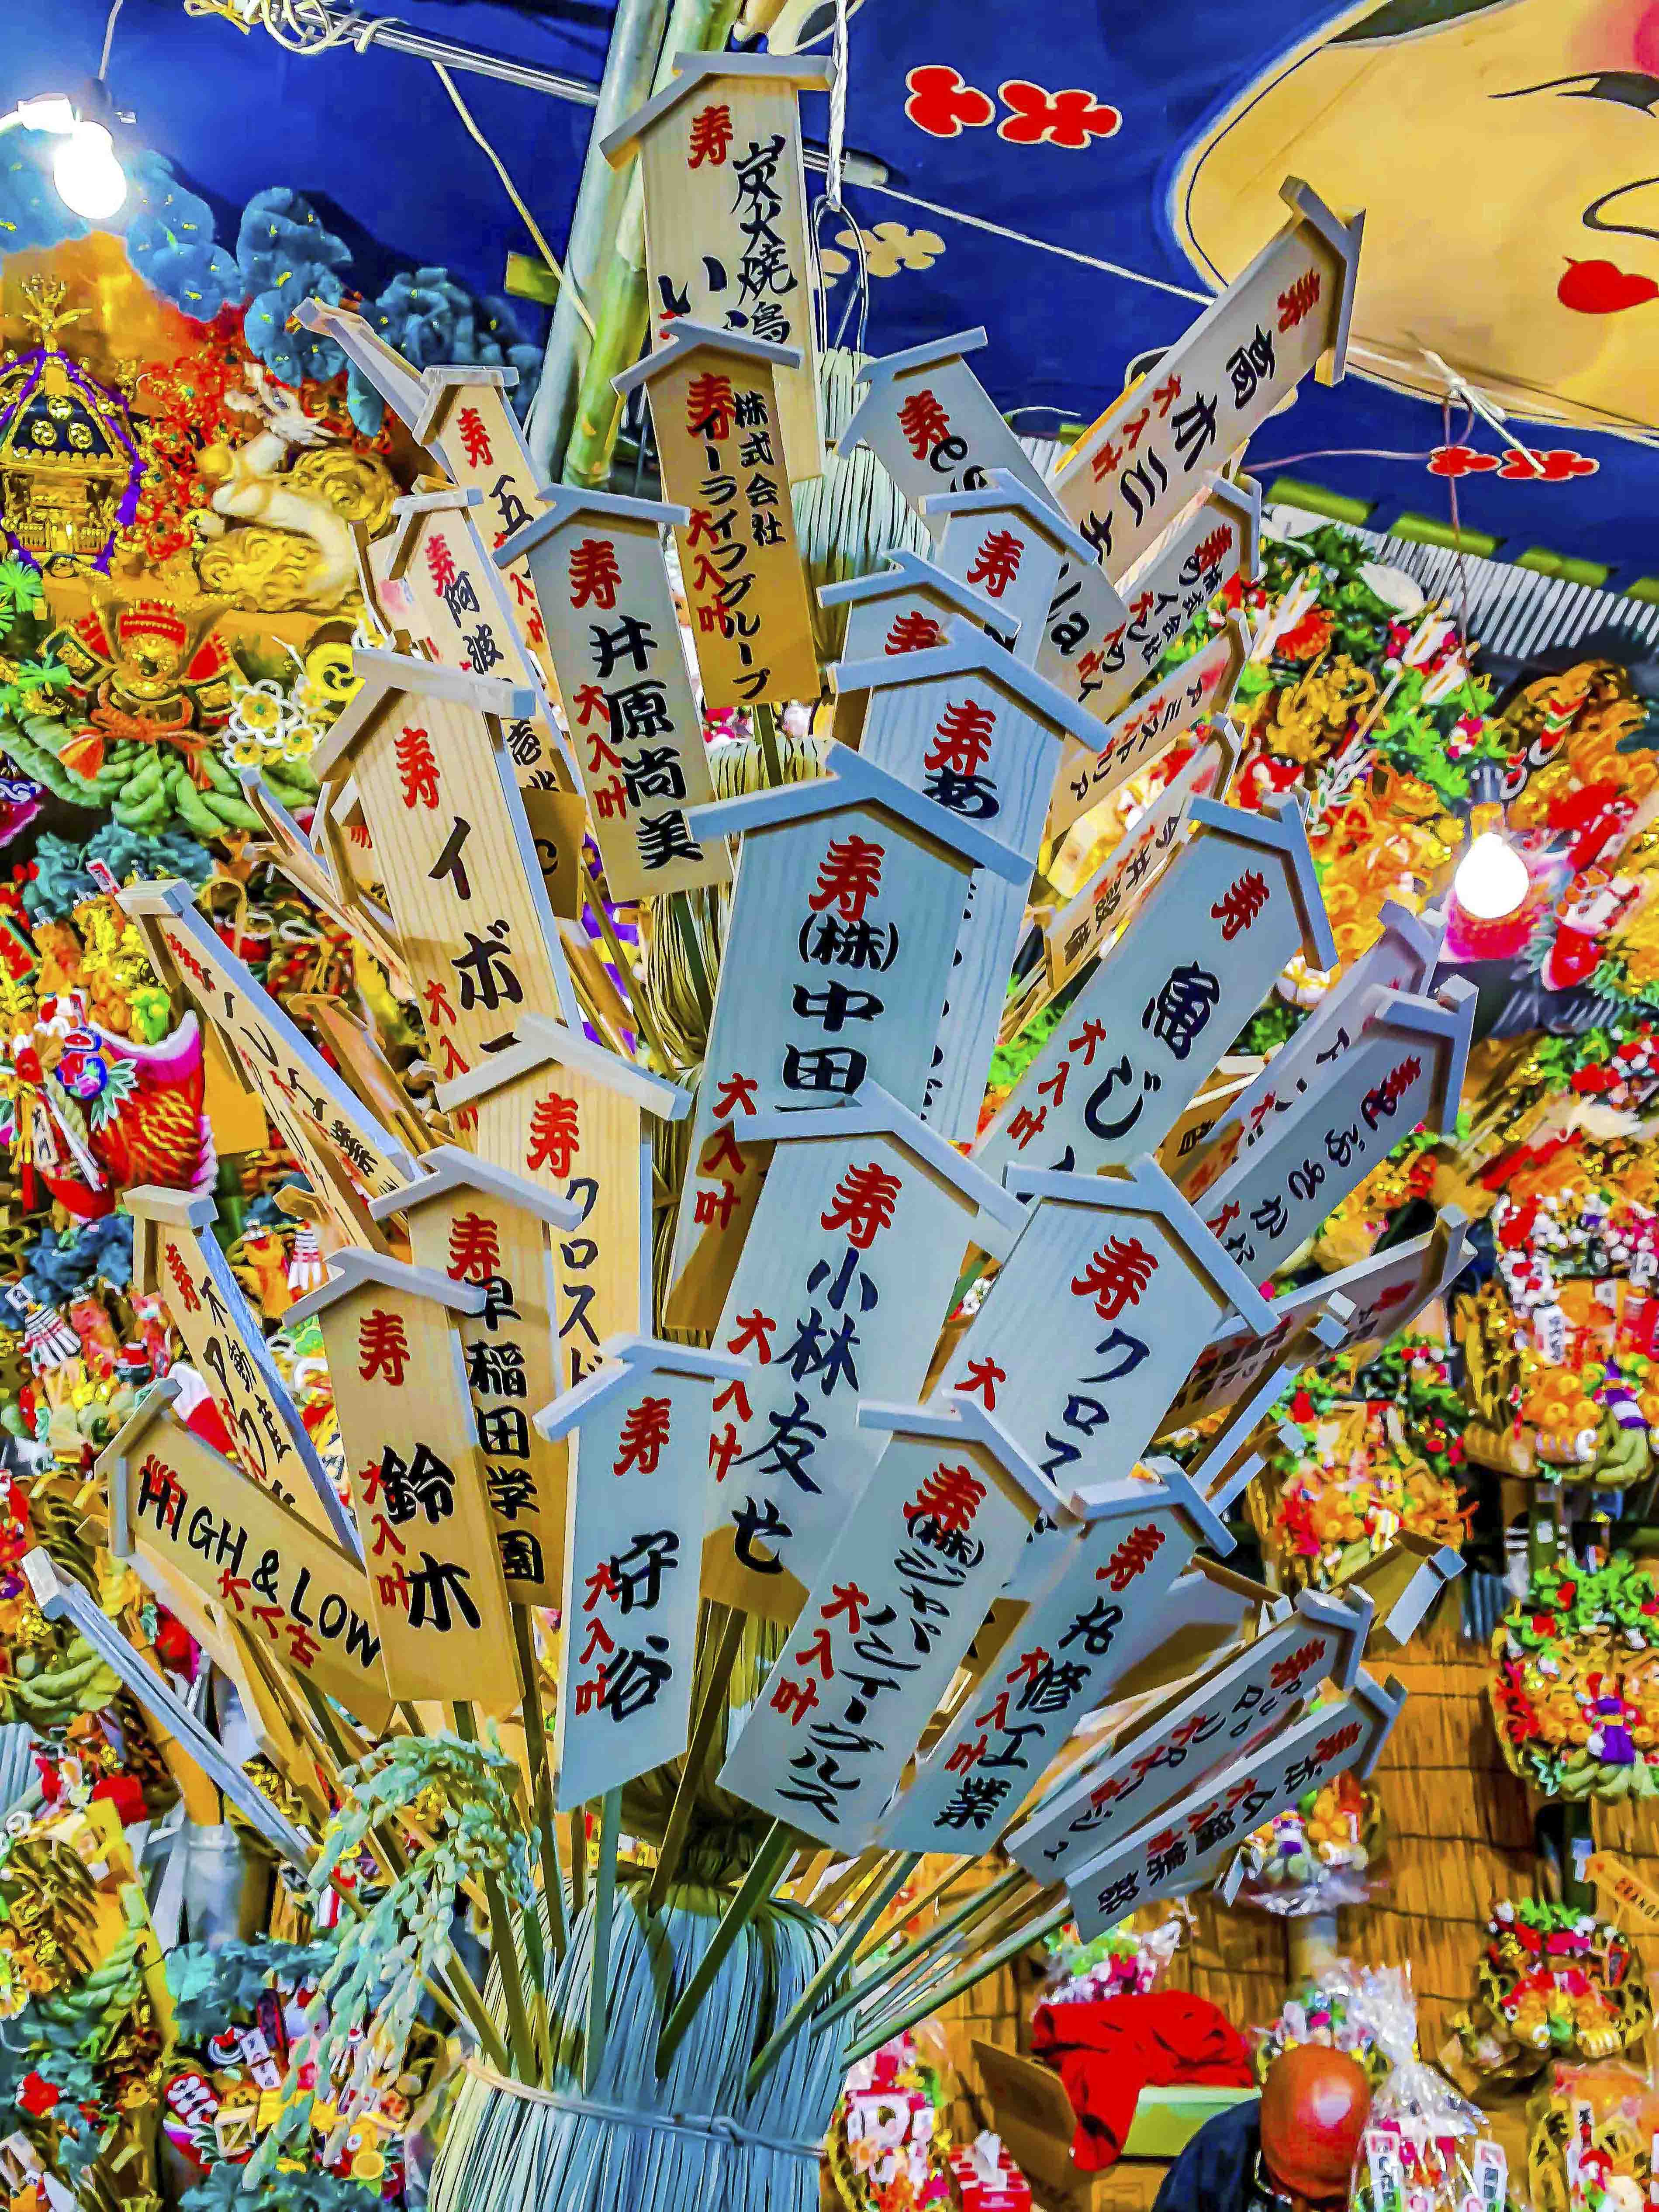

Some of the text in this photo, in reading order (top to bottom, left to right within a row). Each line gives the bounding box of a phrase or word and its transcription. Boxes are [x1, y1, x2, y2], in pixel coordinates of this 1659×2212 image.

[688, 105, 733, 169] 寿
[1277, 267, 1320, 333] 寿
[457, 408, 493, 468] 寿
[687, 373, 736, 440] 寿
[897, 389, 951, 460] 寿
[734, 390, 787, 546] 株式会社
[569, 539, 621, 610] 寿
[967, 530, 1025, 598] 寿
[394, 727, 440, 809] 寿
[573, 684, 628, 819] 大入叶
[590, 615, 704, 870] 井原尚美
[924, 699, 996, 777] 寿
[808, 835, 885, 922] 寿
[1211, 868, 1271, 941] 寿
[1007, 1019, 1106, 1151] 大入叶
[526, 1092, 580, 1179] 寿
[694, 1072, 759, 1230] 大入叶
[820, 1162, 902, 1249] 寿
[446, 1212, 501, 1288] 寿
[1071, 1234, 1159, 1320] 寿
[358, 1309, 410, 1386] 寿
[954, 1356, 1006, 1413] 大
[612, 1397, 672, 1476] 寿
[903, 1462, 987, 1531] 寿
[380, 1442, 482, 1632] 鈴木
[1096, 1524, 1166, 1592] 寿
[770, 1581, 870, 1725] 大入叶
[1271, 1638, 1327, 1689] 寿
